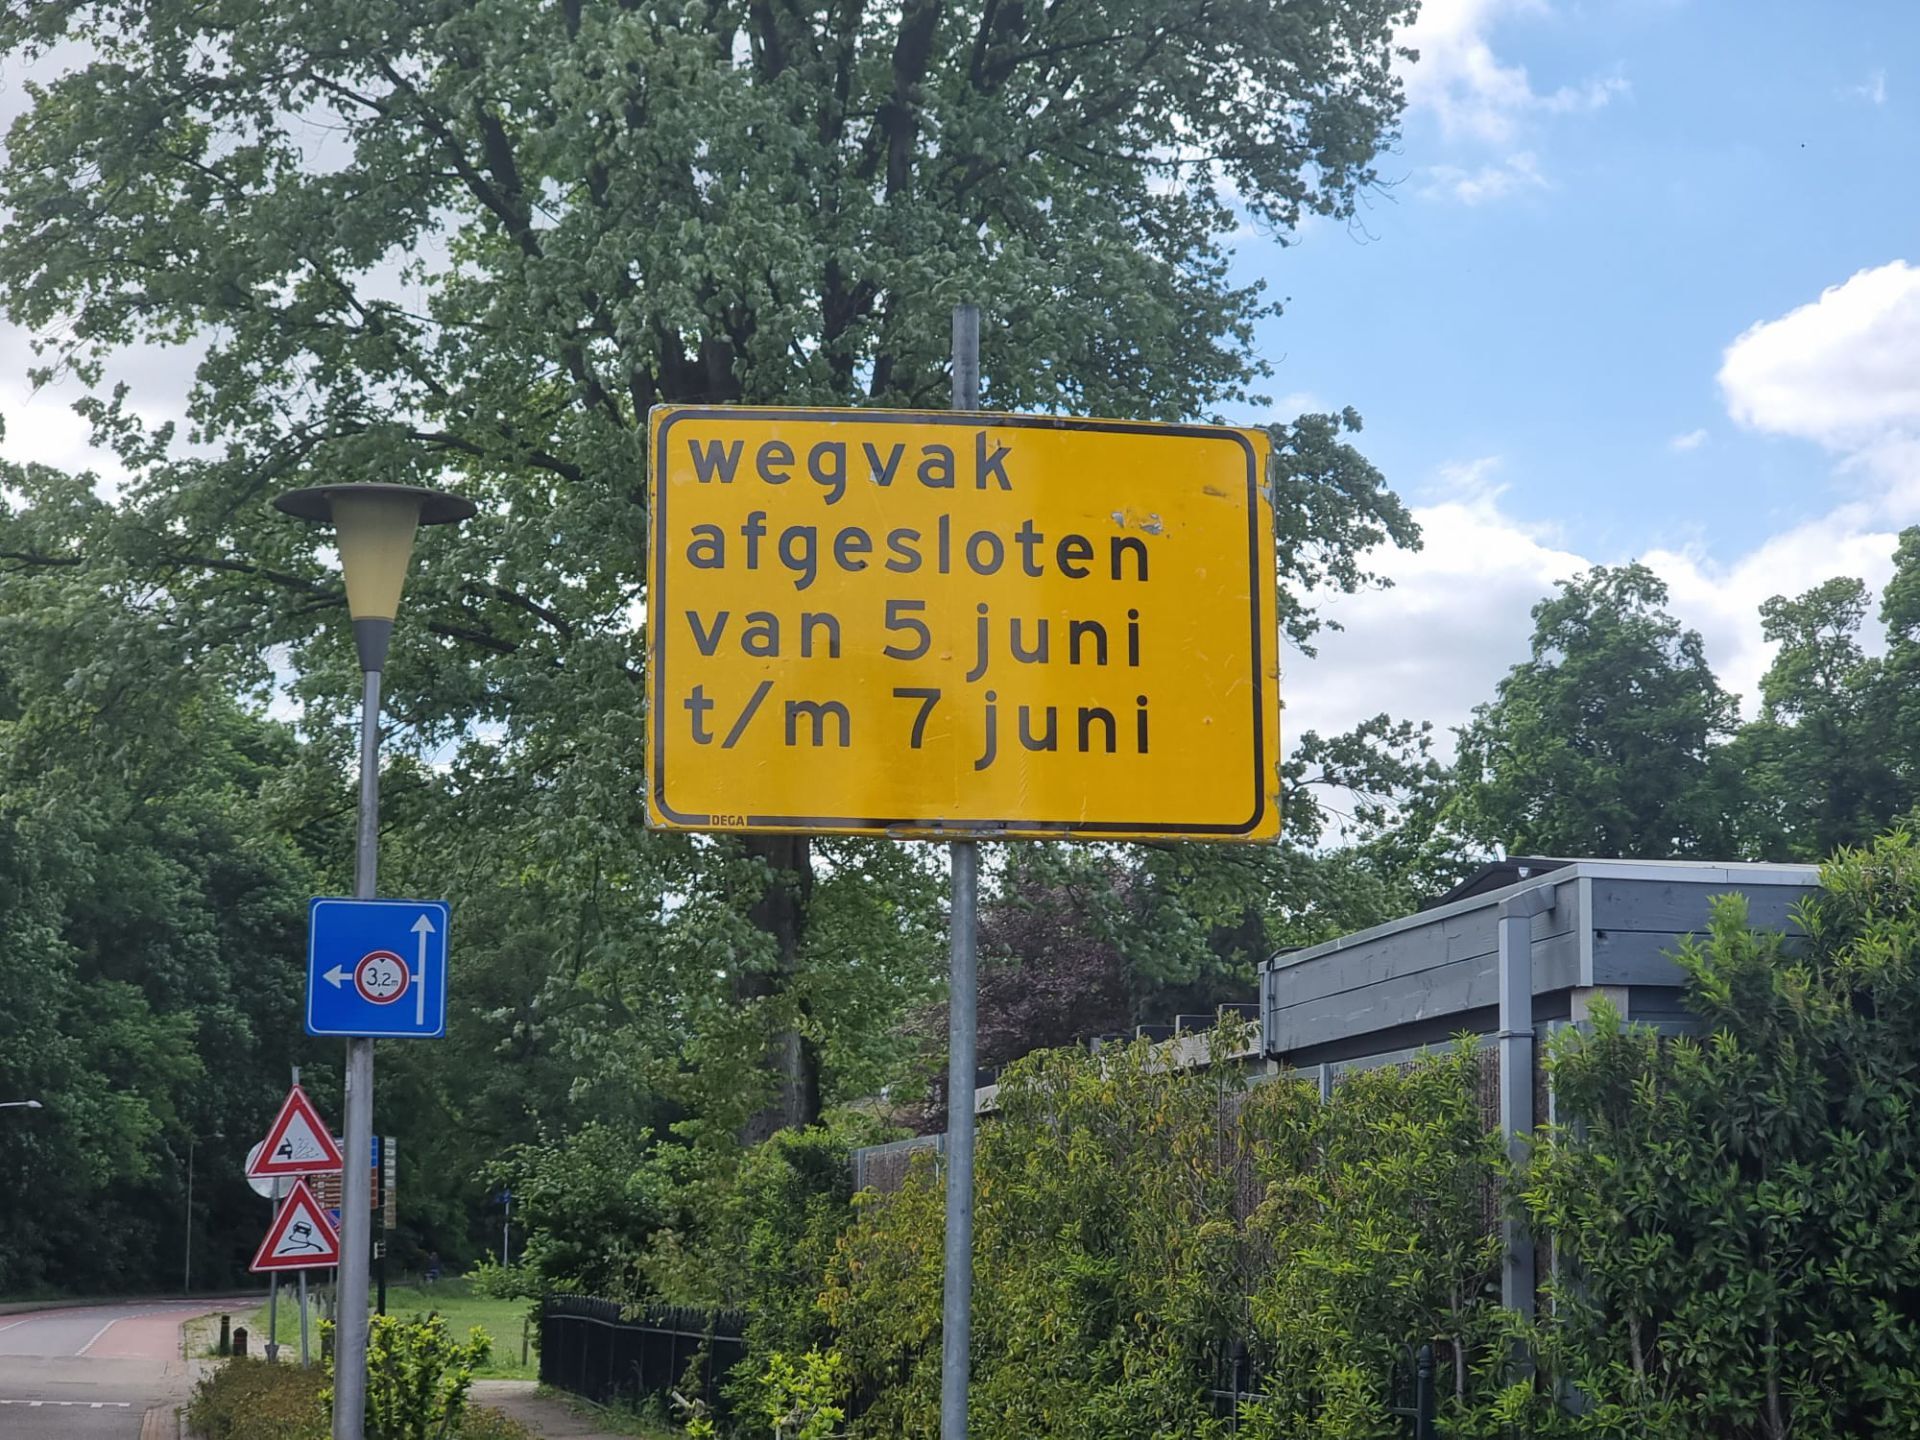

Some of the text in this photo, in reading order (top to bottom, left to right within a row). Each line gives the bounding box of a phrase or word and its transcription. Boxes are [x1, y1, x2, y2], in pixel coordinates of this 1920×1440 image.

[688, 431, 1013, 505] wegvak
[686, 511, 1149, 590] afgesloten
[686, 599, 1140, 682] van 5 juni
[684, 681, 1149, 770] t/m 7 juni
[711, 815, 745, 826] DEGA
